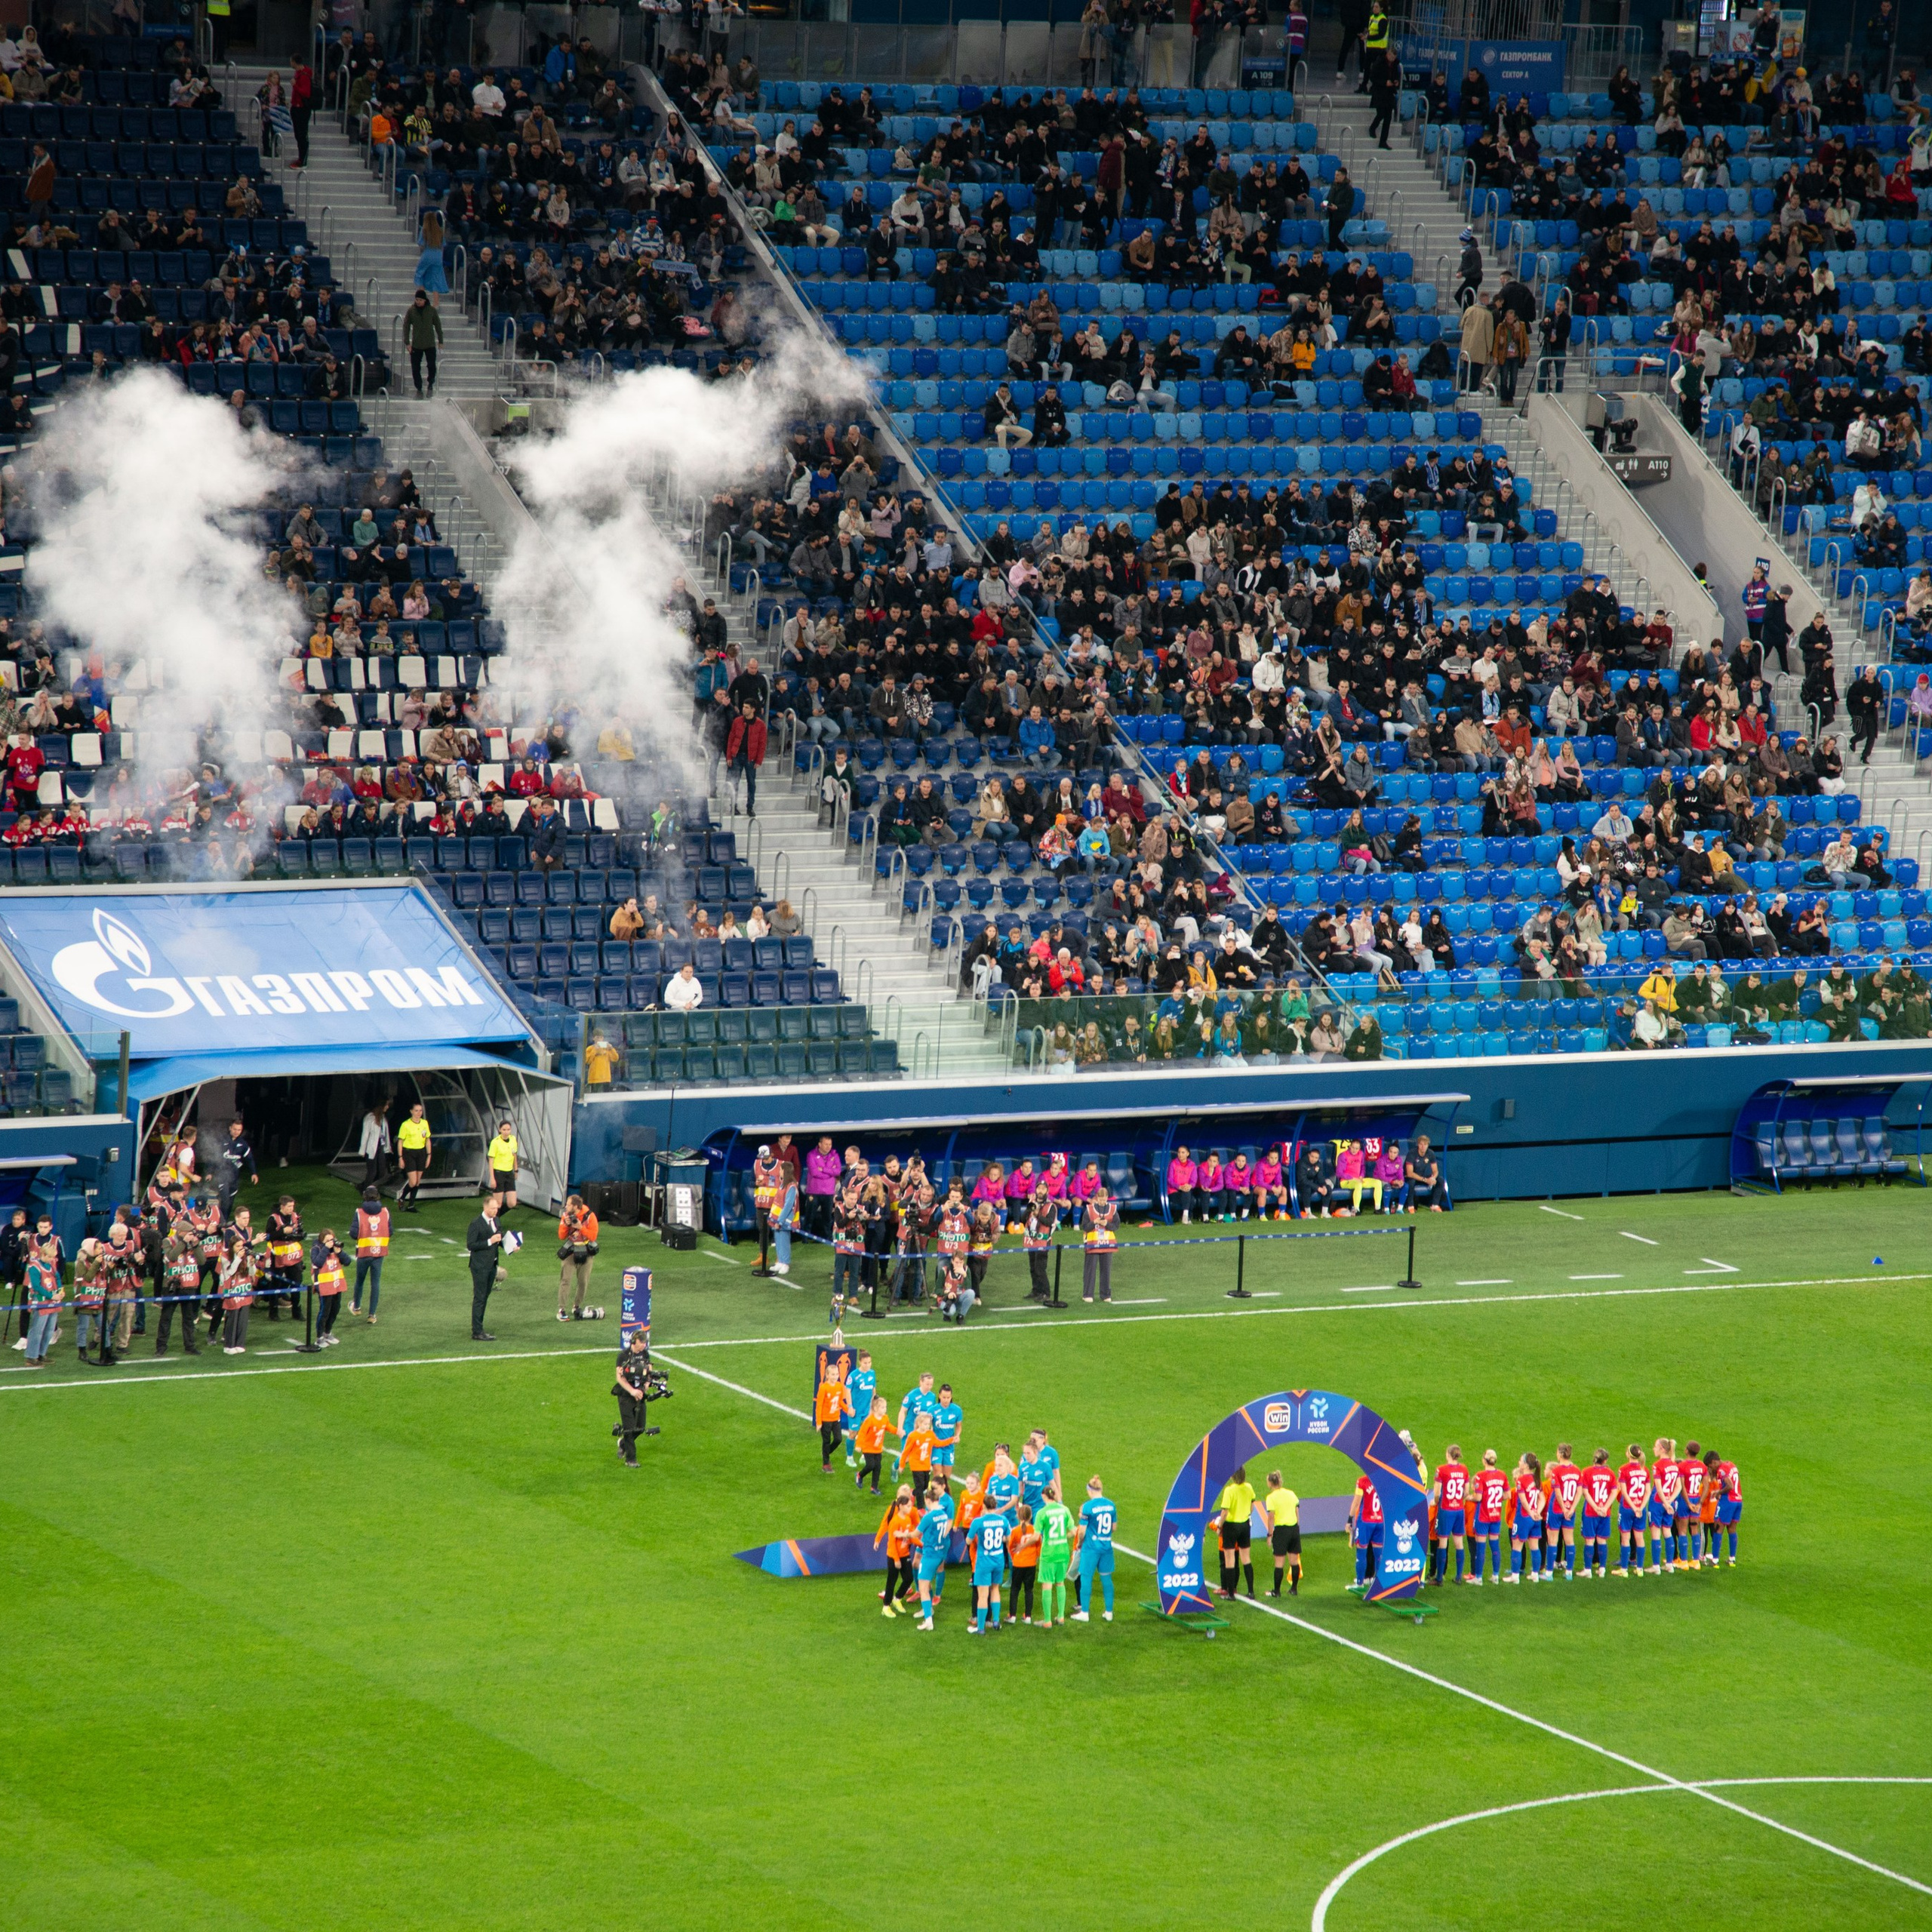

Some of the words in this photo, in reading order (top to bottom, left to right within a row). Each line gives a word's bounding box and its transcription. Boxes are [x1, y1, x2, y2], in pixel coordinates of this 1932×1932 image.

[1418, 48, 1457, 61] ГАЗПРМБАНК
[1500, 51, 1552, 62] ГАЗПРОМБАНК
[1647, 460, 1669, 470] A110
[183, 966, 484, 1017] ГАЗПРОМ
[288, 1251, 300, 1260] 072
[182, 1274, 194, 1282] 165
[1446, 1478, 1465, 1500] 93
[1563, 1480, 1577, 1501] 10
[1592, 1481, 1608, 1503] 14
[1629, 1476, 1646, 1497] 25
[1663, 1472, 1678, 1493] 27
[1688, 1474, 1703, 1494] 18
[1487, 1485, 1503, 1509] 22
[1049, 1515, 1064, 1538] 21
[1097, 1512, 1112, 1535] 19
[983, 1527, 1004, 1550] 88
[1385, 1558, 1420, 1573] 2022
[1163, 1573, 1198, 1589] 2022
